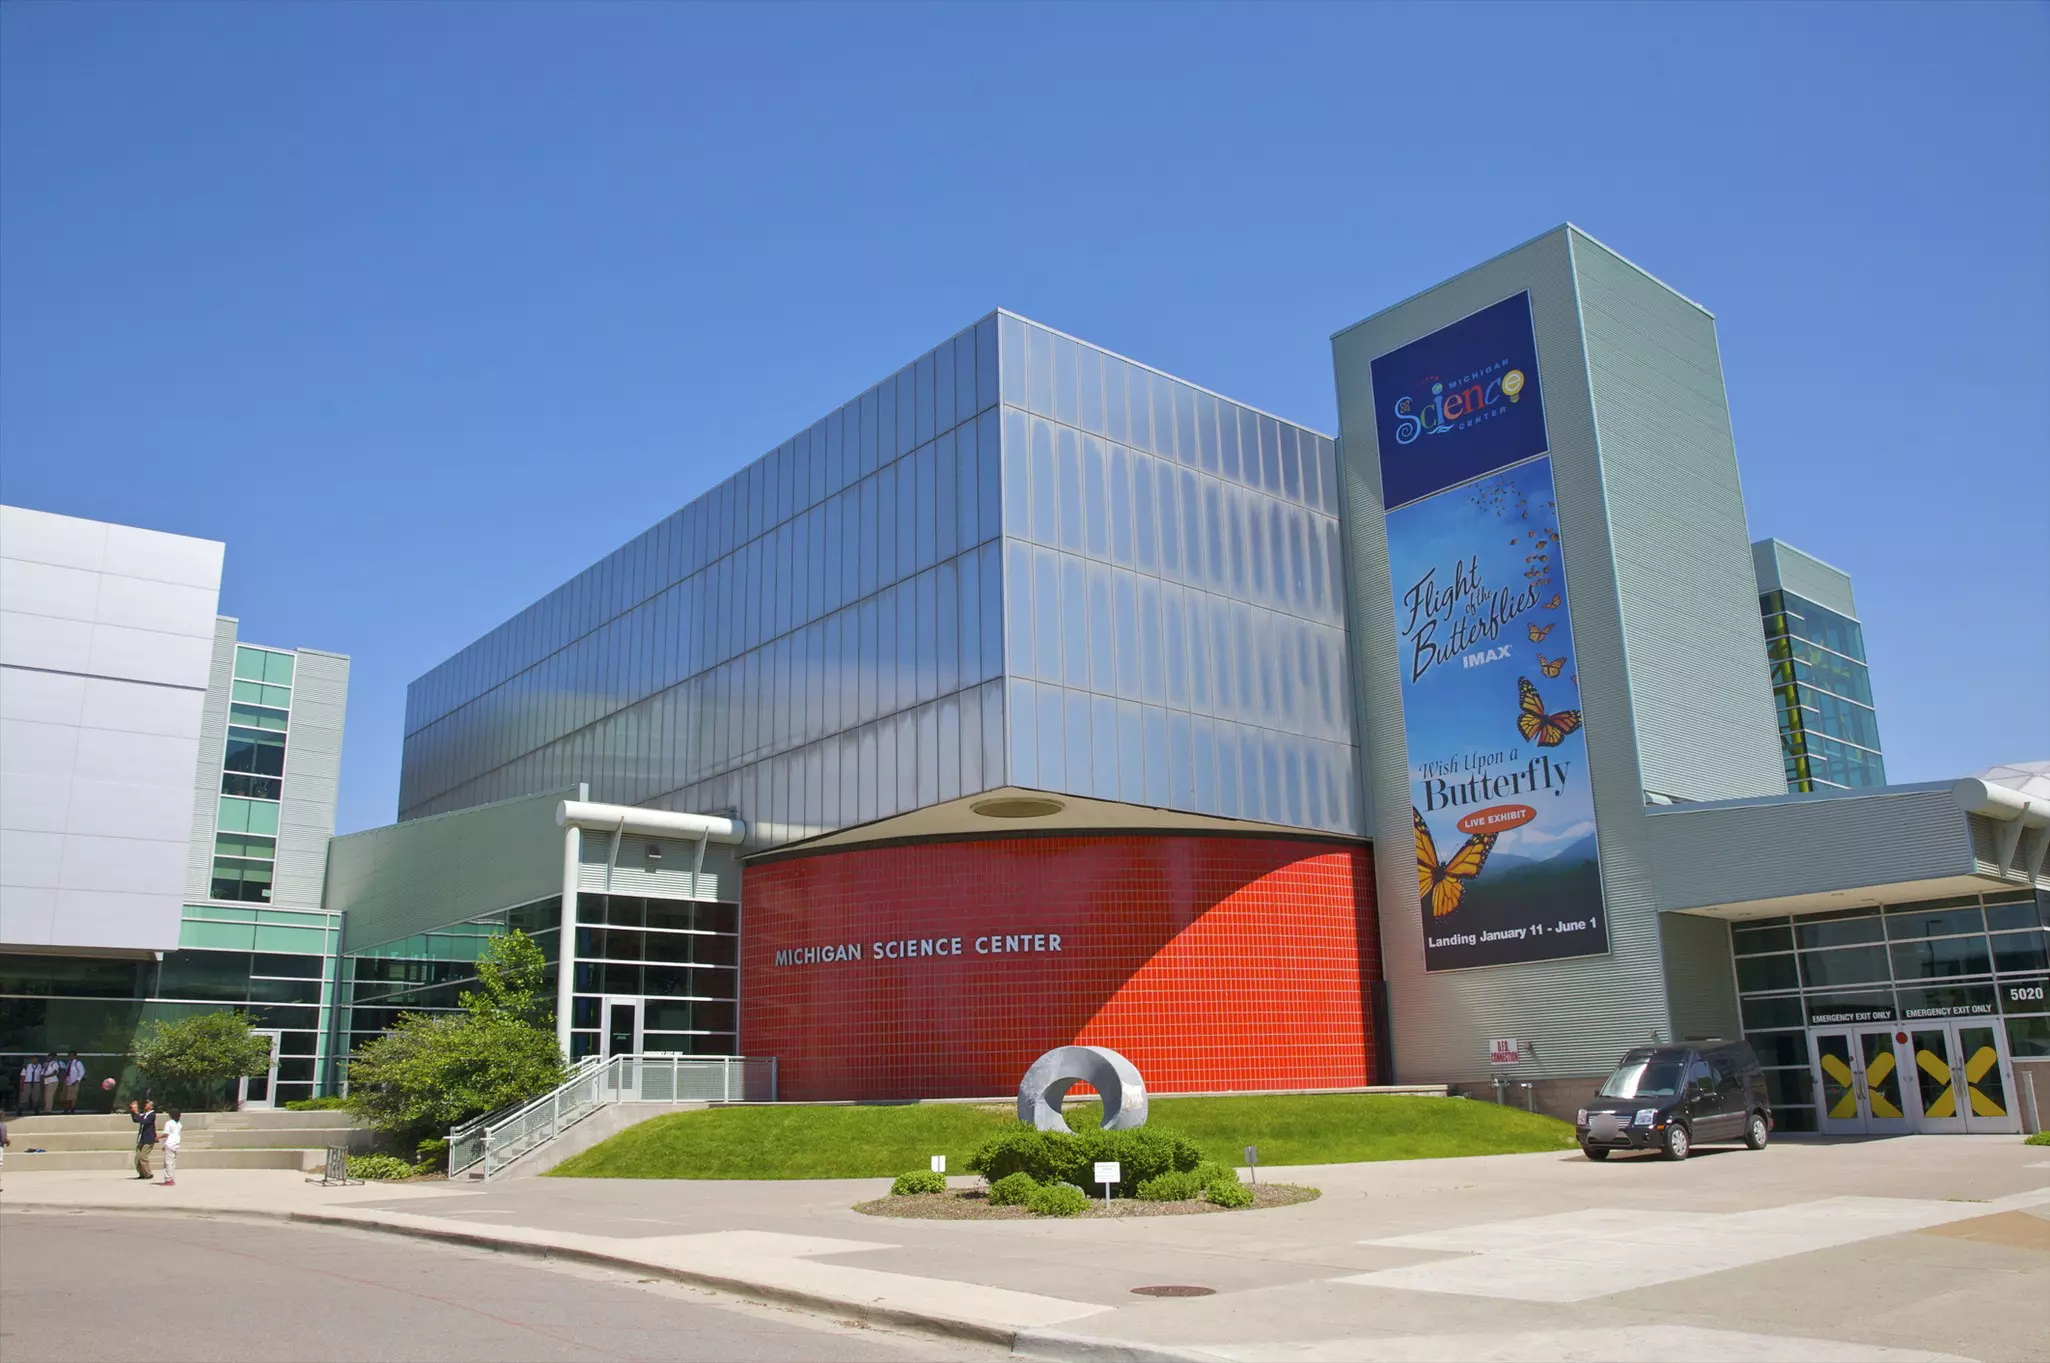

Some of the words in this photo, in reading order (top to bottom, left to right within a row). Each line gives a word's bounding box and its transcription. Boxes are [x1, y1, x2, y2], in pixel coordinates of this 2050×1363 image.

[1448, 358, 1509, 389] MICHIGAN
[1394, 372, 1523, 445] Science
[1458, 406, 1507, 430] CENTER
[1401, 554, 1482, 636] Flight
[1465, 591, 1476, 616] of
[1476, 586, 1492, 606] the
[1410, 584, 1541, 684] Butterflies
[1462, 645, 1511, 669] IMAX
[1419, 753, 1459, 780] Wish
[1464, 750, 1504, 775] Upon
[1509, 747, 1518, 761] a
[1422, 755, 1572, 813] Butterfly
[1464, 816, 1486, 829] LIVE
[1487, 809, 1527, 825] EXHIBIT
[1428, 932, 1476, 948] Landing
[1479, 926, 1526, 942] January
[1529, 924, 1543, 936] 11
[1555, 919, 1586, 933] June
[1589, 917, 1597, 928] 1
[775, 943, 863, 967] MICHIGAN
[872, 937, 962, 960] SCIENCE
[975, 933, 1062, 955] CENTER
[2009, 987, 2044, 1001] 5020
[1811, 1013, 1854, 1023] EMERGENCY
[1855, 1012, 1871, 1021] EXIT
[1872, 1010, 1891, 1020] ONLY
[1905, 1006, 1952, 1018] EMERGENCY
[1953, 1005, 1971, 1015] EXIT
[1971, 1004, 1992, 1014] ONLY
[1490, 1051, 1519, 1063] CONNECTION
